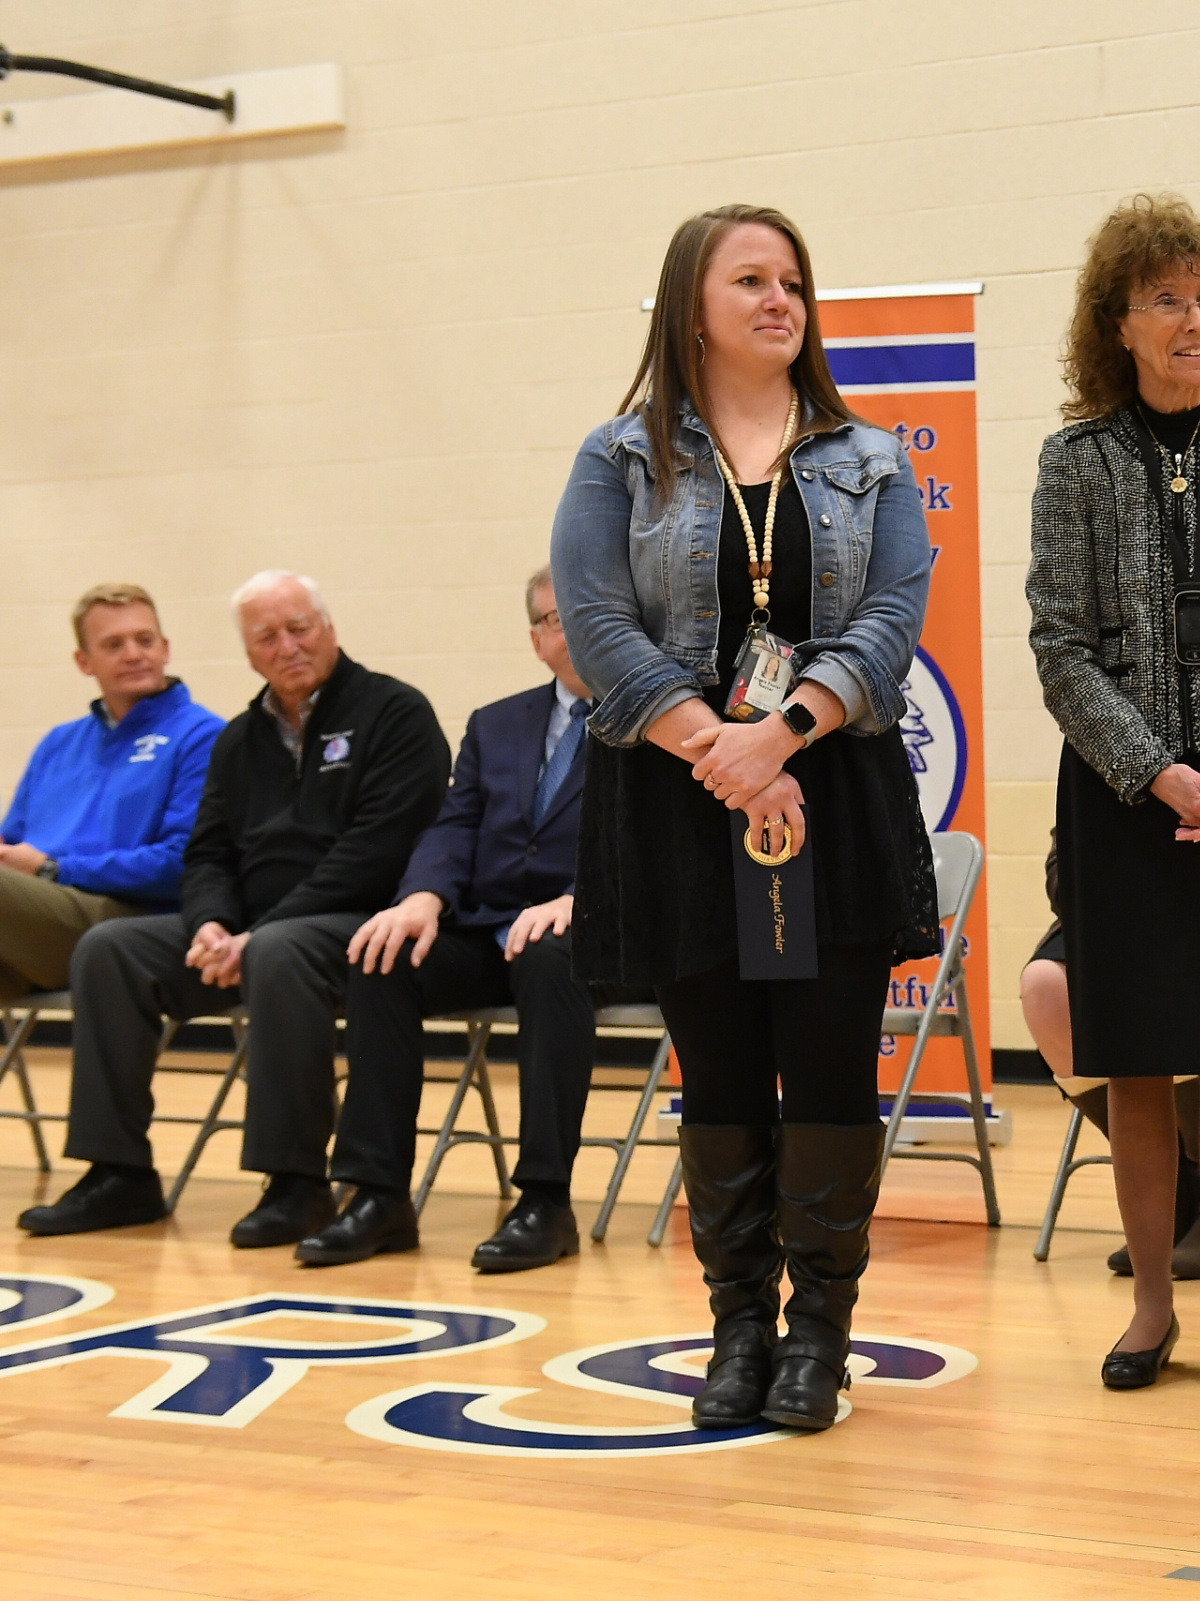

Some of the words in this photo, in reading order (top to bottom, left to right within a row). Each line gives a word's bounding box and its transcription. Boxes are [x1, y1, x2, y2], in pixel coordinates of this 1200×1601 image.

[895, 423, 936, 452] to
[769, 873, 783, 914] Angela
[774, 913, 786, 954] Fowler
